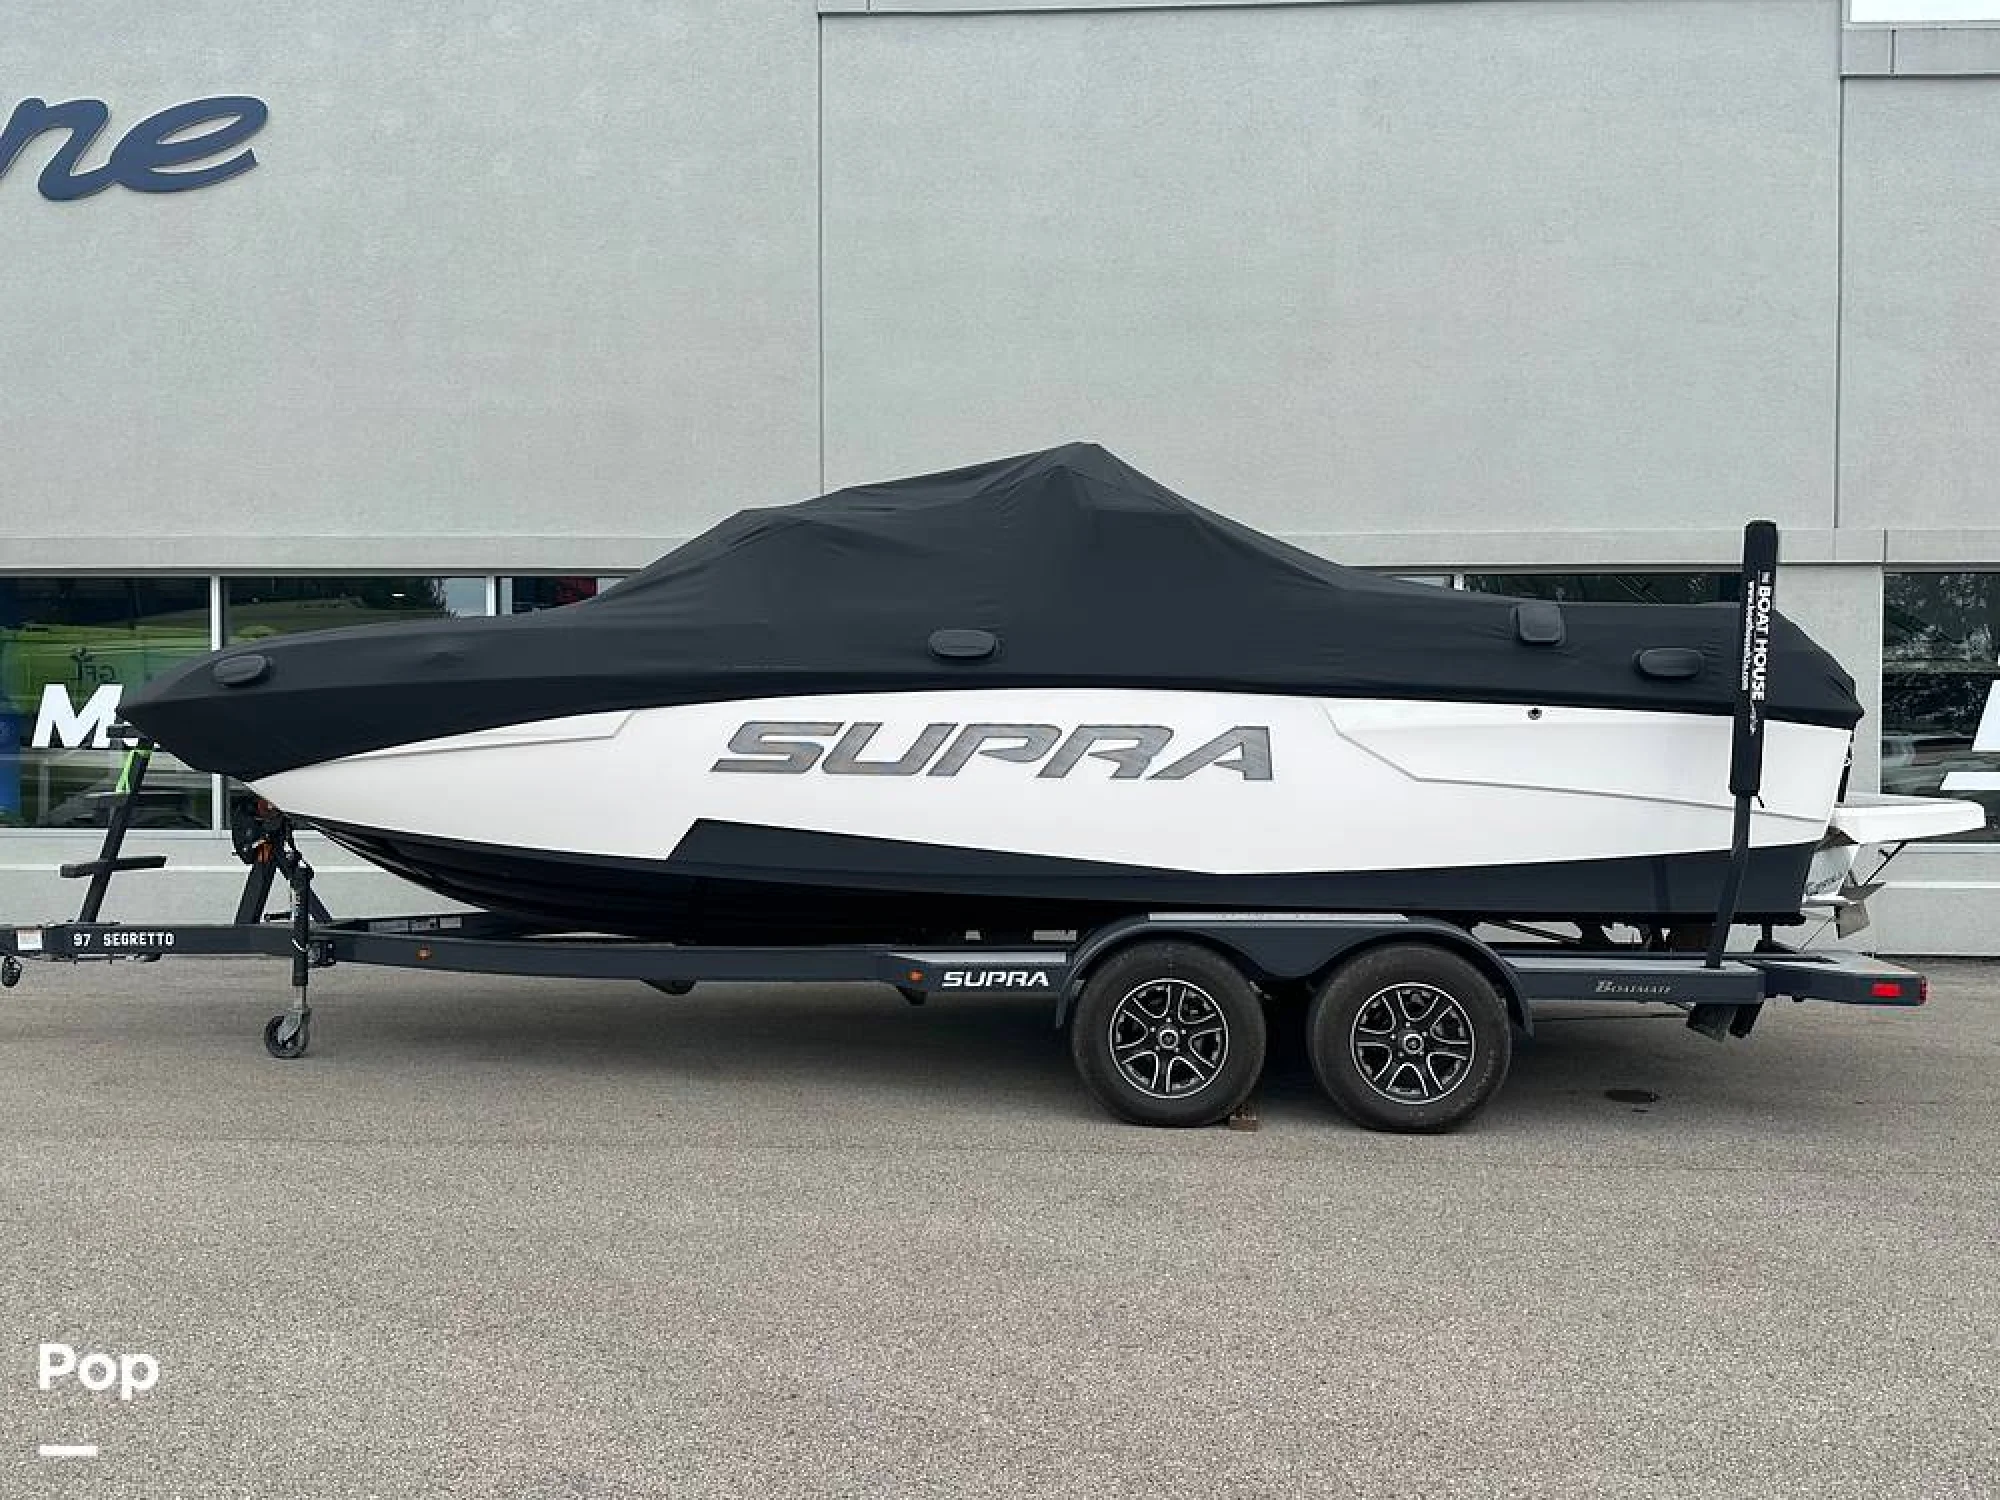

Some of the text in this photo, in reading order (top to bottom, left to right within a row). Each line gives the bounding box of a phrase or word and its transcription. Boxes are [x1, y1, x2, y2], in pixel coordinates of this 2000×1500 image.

[1755, 585, 1771, 634] BOAT
[1751, 639, 1768, 701] HOUSE
[709, 721, 1273, 780] SUPRA
[73, 932, 91, 946] 97
[942, 971, 1050, 987] SUPRA
